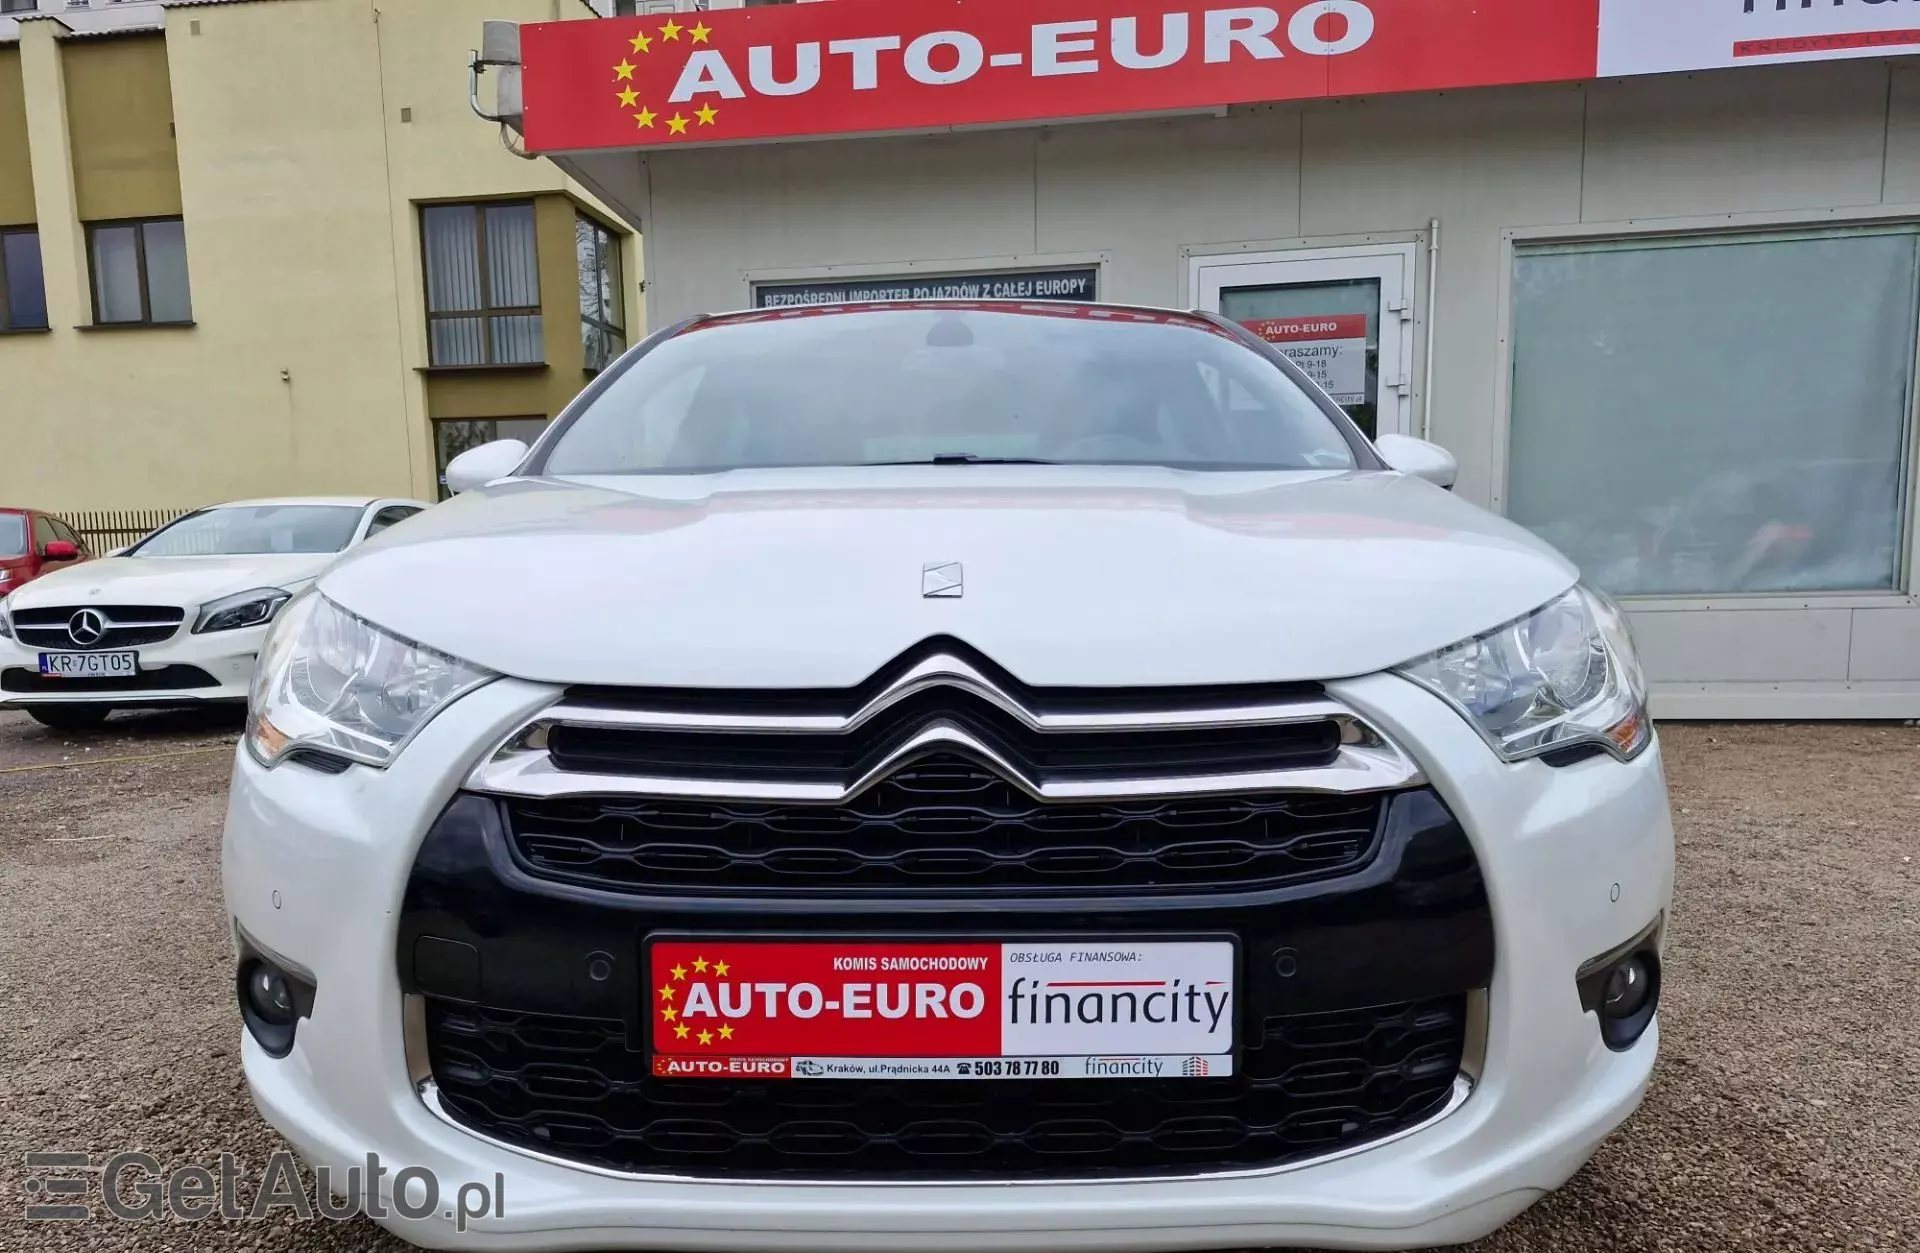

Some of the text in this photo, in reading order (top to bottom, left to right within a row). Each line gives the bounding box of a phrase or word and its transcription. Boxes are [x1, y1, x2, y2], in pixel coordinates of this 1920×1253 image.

[668, 0, 1375, 103] AUTO-EURO
[764, 278, 1086, 307] BEZPOŚREDNI IMPORTER POJAZDÓW Z CAŁEJ EUROPY
[1265, 322, 1337, 335] AUTO-EURO
[49, 654, 132, 672] KR 7GT05
[833, 957, 988, 971] KOMIS SAMOCHODOWY
[1010, 951, 1143, 963] OBSŁUGA FINANSOWA:
[681, 982, 985, 1019] AUTO-EURO
[1008, 977, 1229, 1034] financity
[667, 1061, 785, 1073] AUTO-EURO
[826, 1063, 866, 1074] Kraków,
[931, 1064, 951, 1073] 44A
[975, 1060, 1059, 1075] 503 78 77 80
[1085, 1057, 1163, 1077] financity
